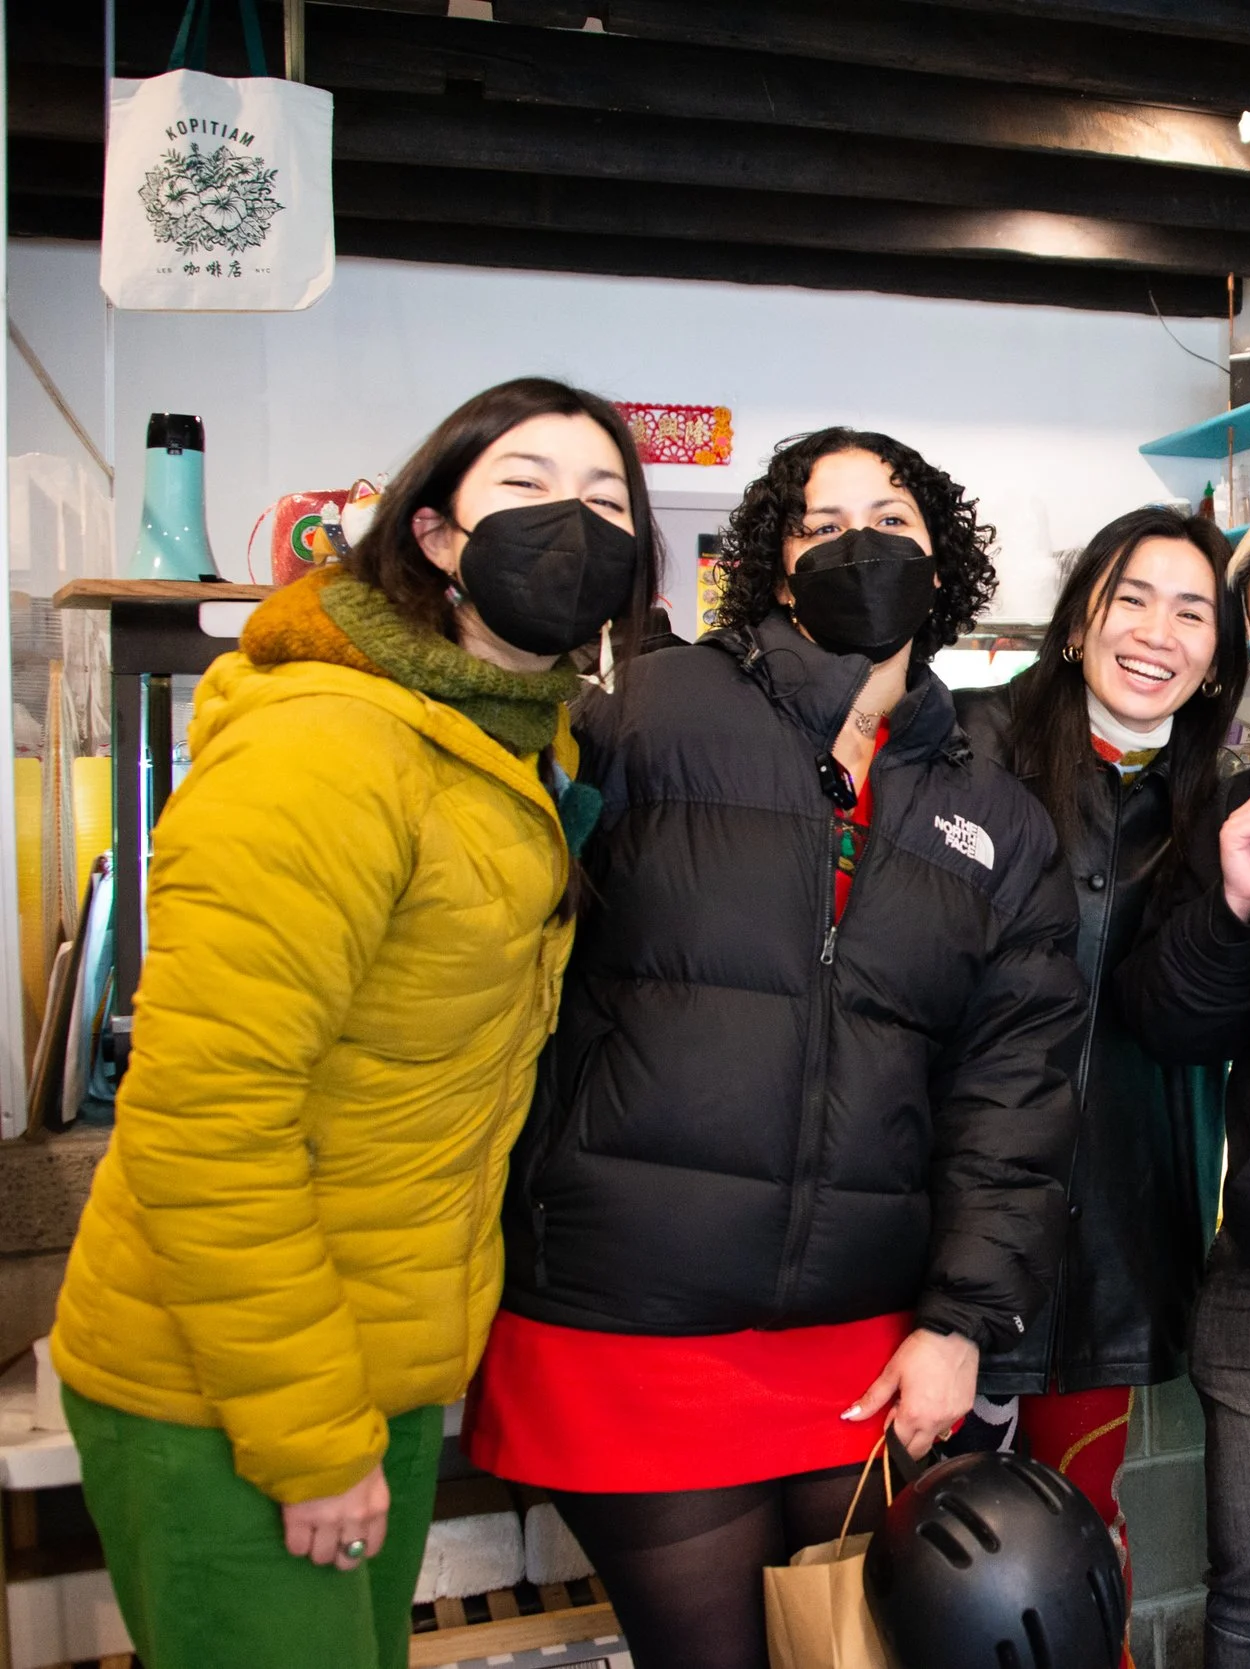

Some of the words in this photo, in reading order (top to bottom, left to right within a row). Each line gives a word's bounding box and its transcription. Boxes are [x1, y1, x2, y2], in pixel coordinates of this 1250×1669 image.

[165, 118, 256, 147] KOPITIAM
[183, 260, 243, 278] 咖啡店
[934, 815, 977, 851] NORTH
[953, 814, 979, 834] THE
[945, 832, 976, 860] FACE
